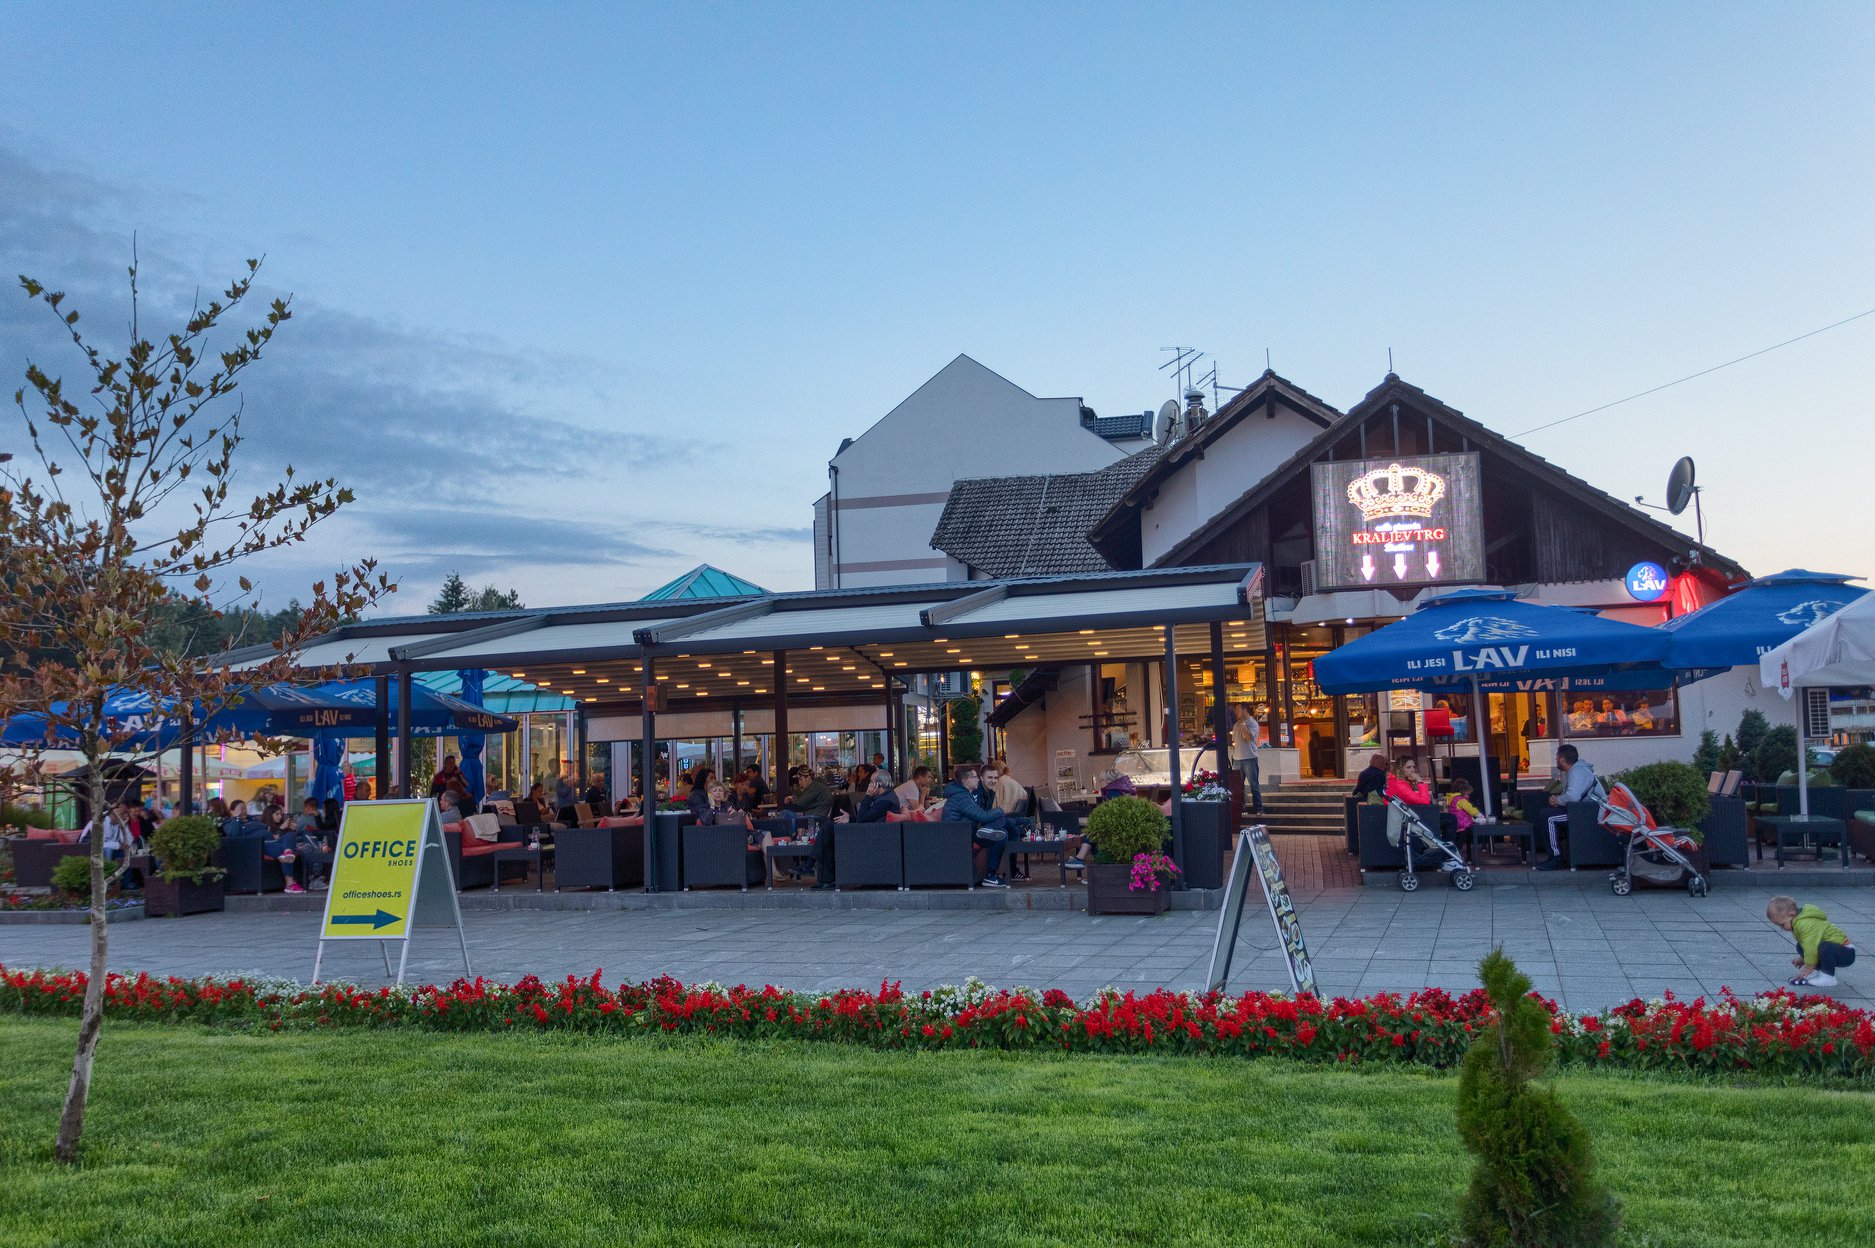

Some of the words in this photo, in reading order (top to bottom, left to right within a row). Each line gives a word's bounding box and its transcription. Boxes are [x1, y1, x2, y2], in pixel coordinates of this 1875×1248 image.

[1353, 530, 1412, 545] KRALJEV
[1414, 528, 1444, 541] TRG
[1633, 580, 1666, 591] LAV
[1407, 658, 1421, 669] ILI
[1424, 657, 1446, 668] JESI
[1452, 644, 1530, 671] LAV
[1536, 649, 1550, 659] ILI
[1552, 647, 1577, 658] NISI
[314, 709, 339, 726] LAV
[343, 840, 417, 859] OFFICE
[387, 859, 413, 867] SHOES
[342, 889, 402, 899] officeshoes.rs
